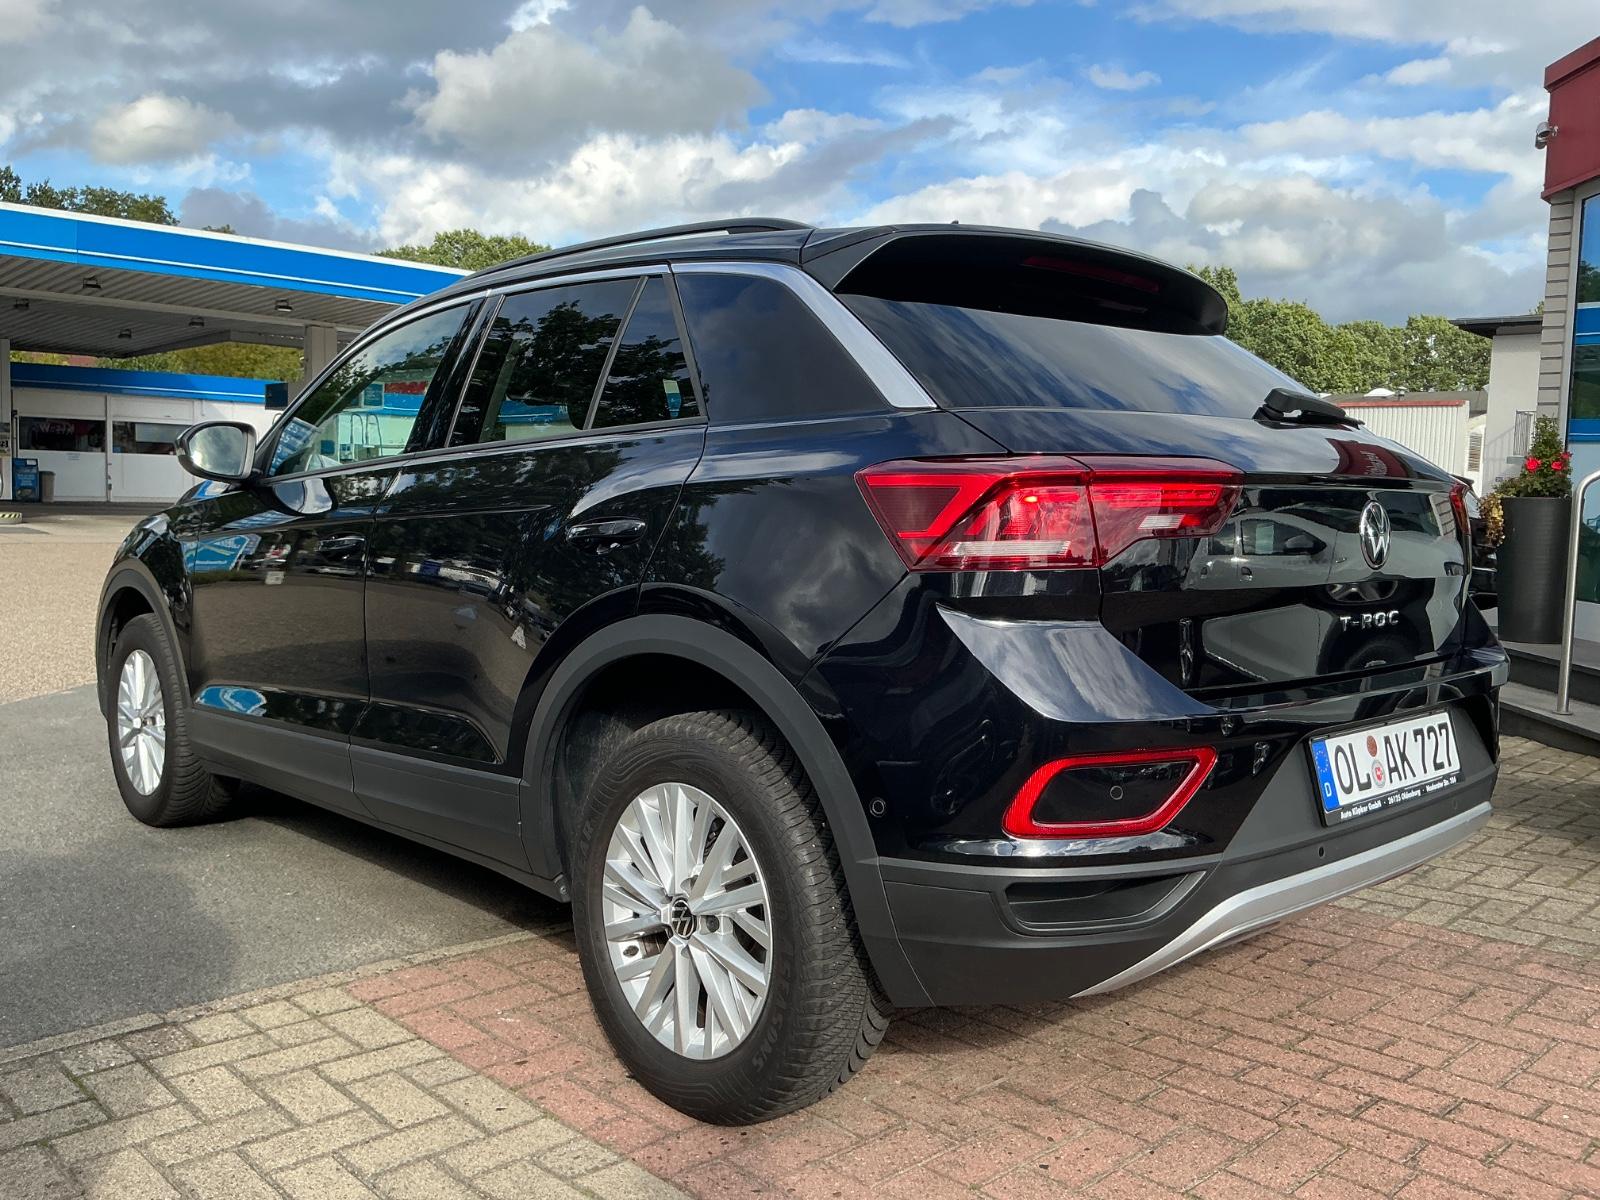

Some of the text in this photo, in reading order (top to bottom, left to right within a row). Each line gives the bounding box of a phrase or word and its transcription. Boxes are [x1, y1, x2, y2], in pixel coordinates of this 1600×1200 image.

[1340, 610, 1399, 632] T-ROC
[1334, 722, 1453, 795] OL AK 727
[1324, 782, 1332, 797] D
